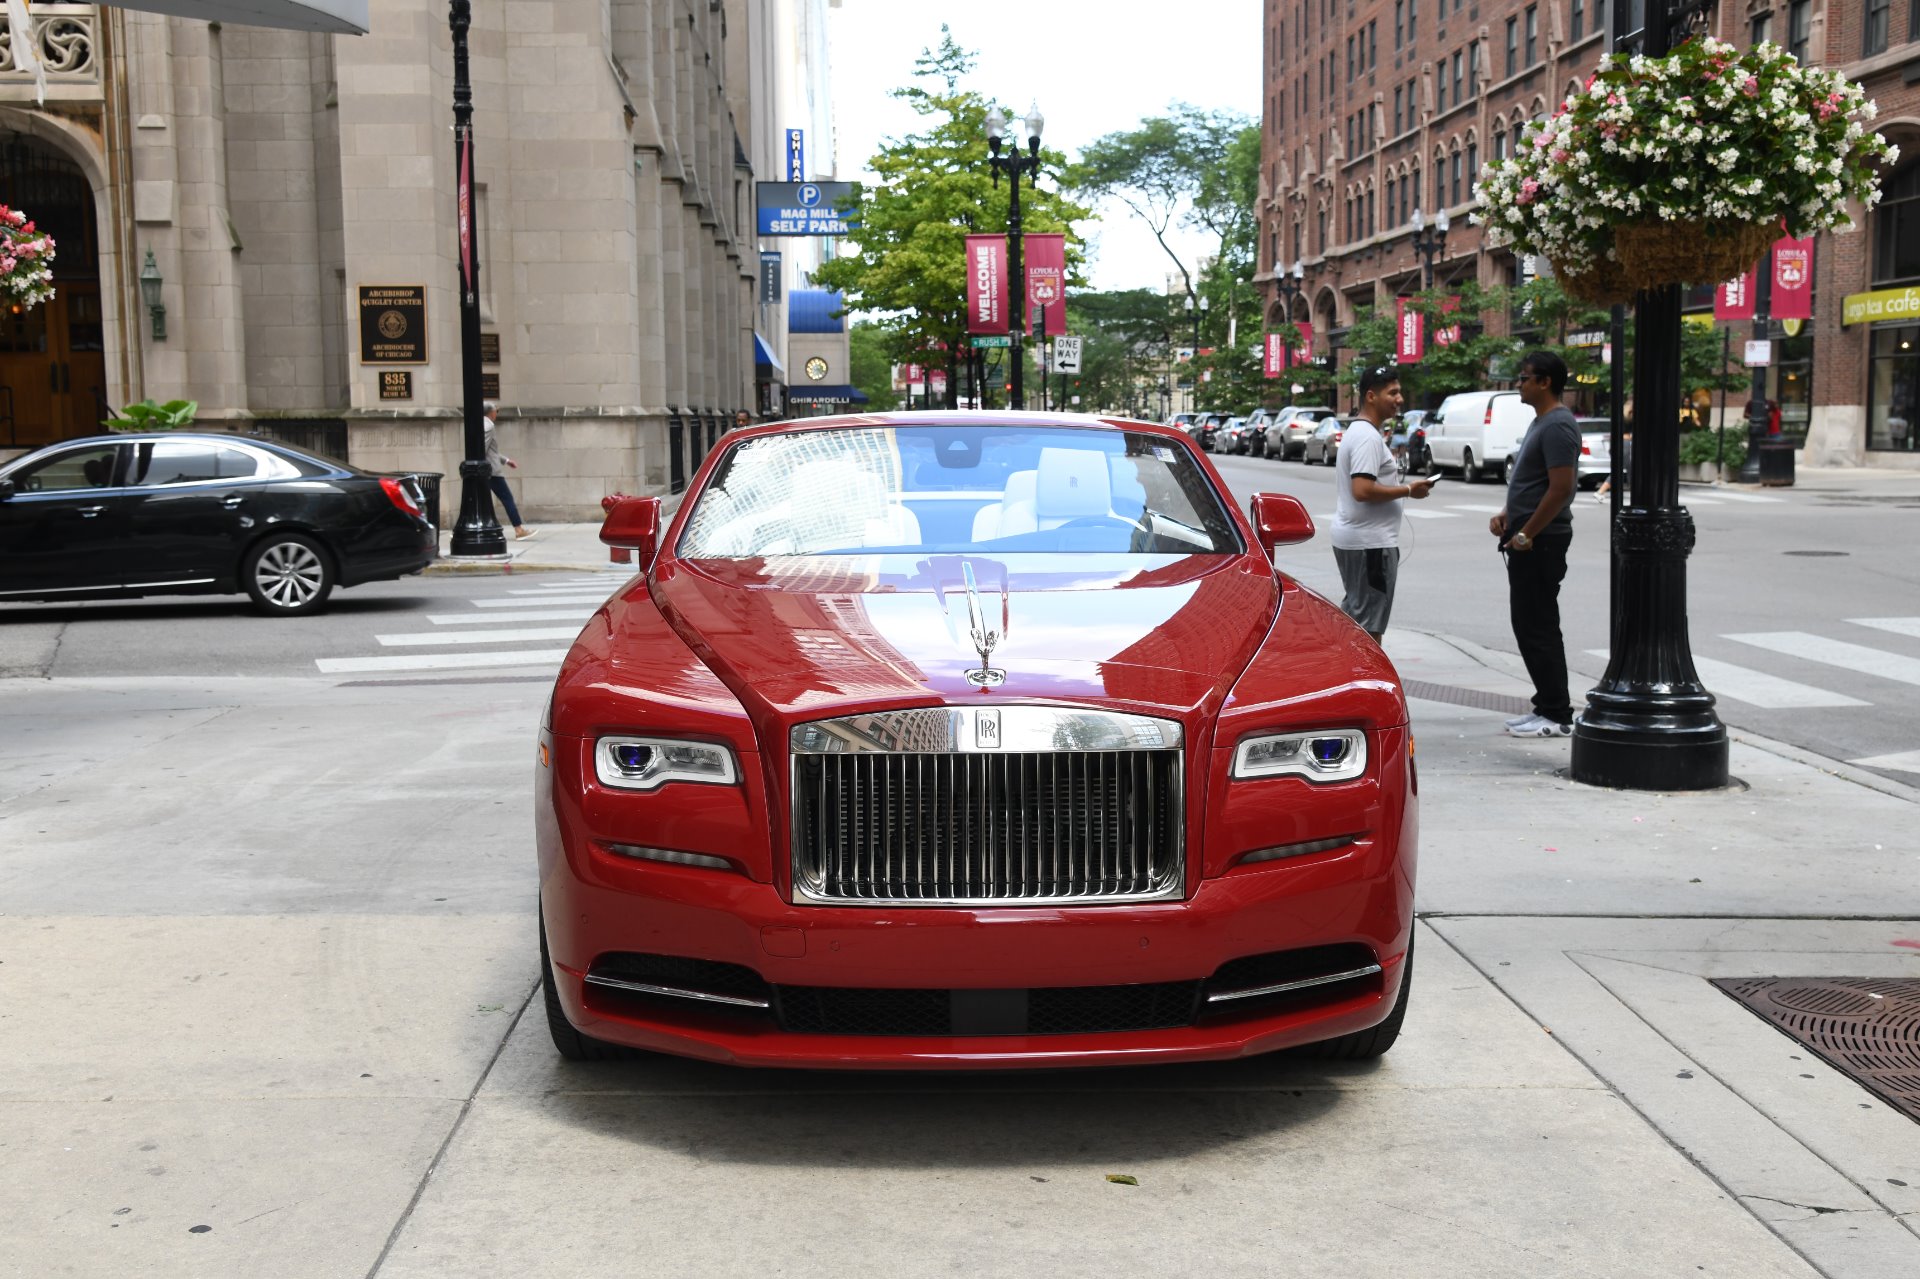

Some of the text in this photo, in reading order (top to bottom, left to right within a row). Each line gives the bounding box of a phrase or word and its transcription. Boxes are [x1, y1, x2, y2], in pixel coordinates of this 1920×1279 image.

[781, 208, 838, 219] MAG MILE
[770, 220, 848, 232] SELF PARK
[989, 246, 997, 273] CAMPUS
[1030, 267, 1060, 275] LOYOLA
[977, 246, 991, 322] WELCOME
[361, 298, 392, 307] QUIGLEY
[1885, 288, 1920, 312] café
[979, 338, 999, 347] RUSH
[1058, 339, 1078, 349] ONE
[1057, 349, 1078, 359] WAY
[384, 373, 406, 385] 835
[790, 396, 850, 404] GHIRARDELLI
[980, 719, 996, 739] RR
